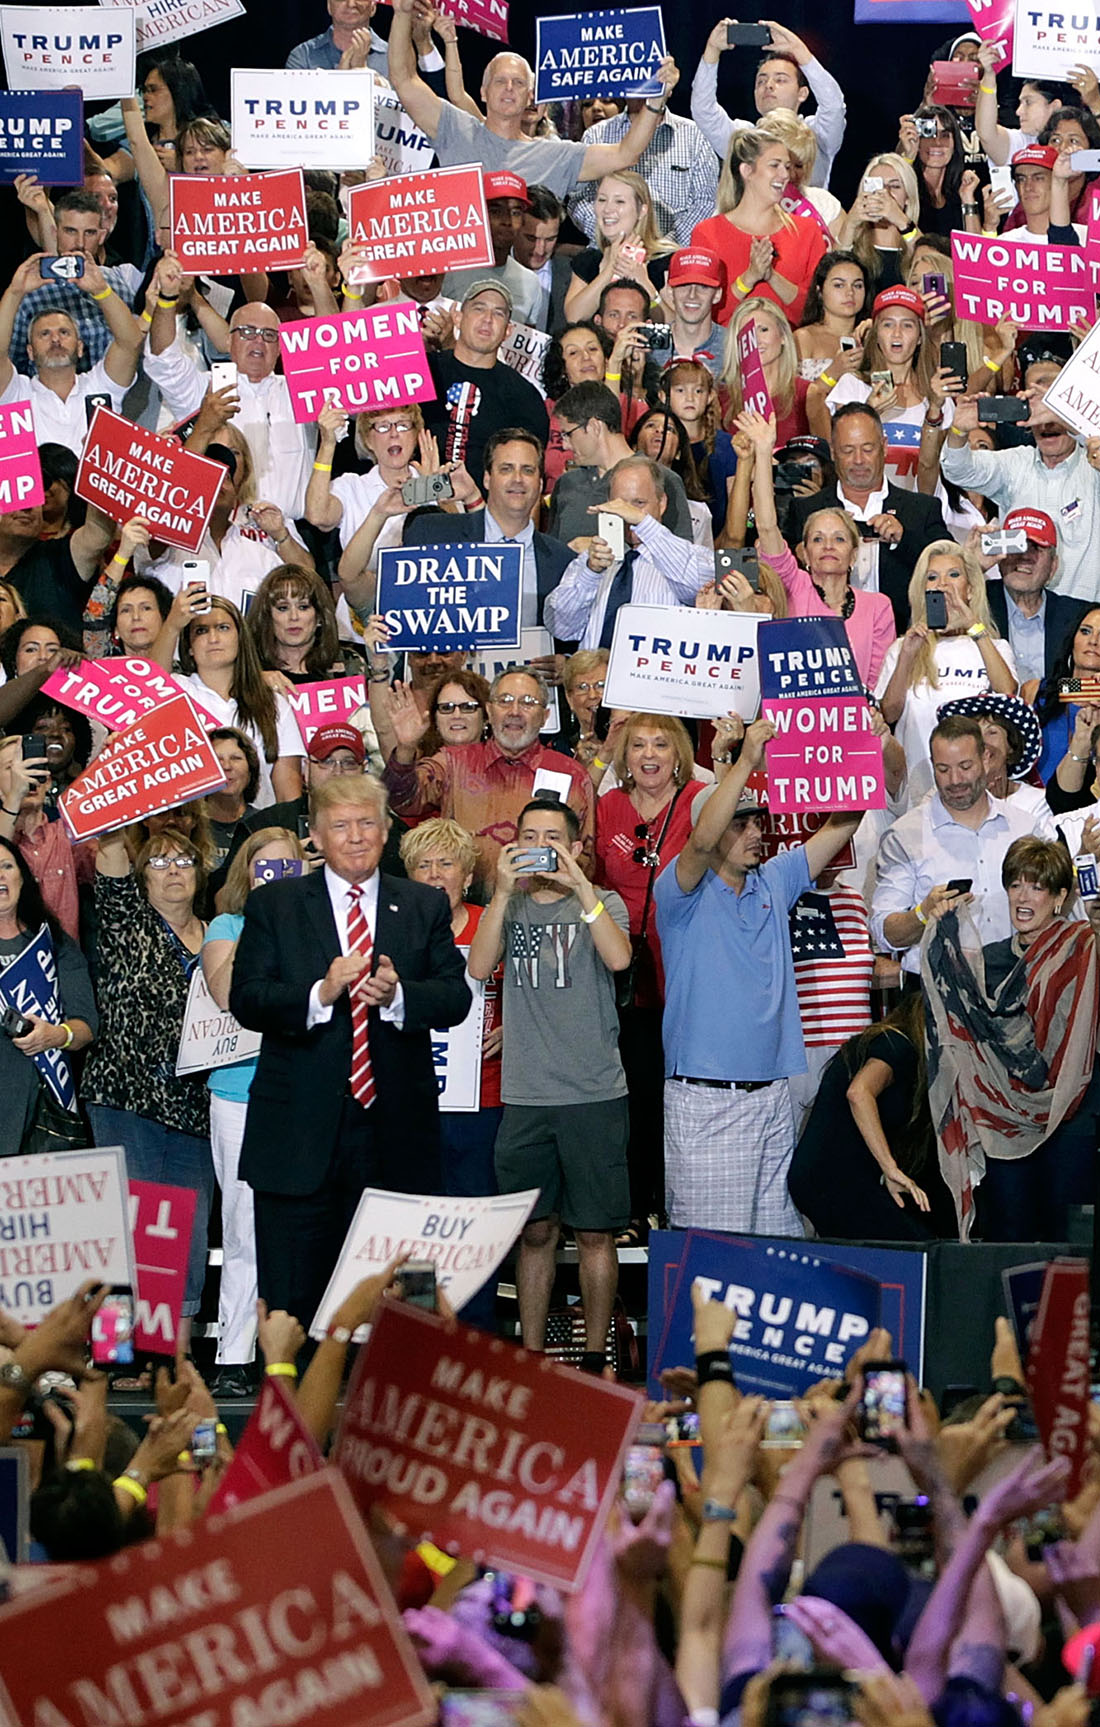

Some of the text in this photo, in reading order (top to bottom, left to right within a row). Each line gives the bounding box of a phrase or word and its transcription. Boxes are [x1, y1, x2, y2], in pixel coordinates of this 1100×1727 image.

[12, 33, 123, 51] TRUMP
[580, 25, 624, 42] MAKE
[23, 53, 113, 64] PENCE
[540, 41, 664, 71] AMERICA
[551, 67, 653, 88] SAFE AGAIN
[244, 100, 360, 115] TRUMP
[0, 118, 72, 135] UMP
[255, 119, 349, 130] PENCE
[375, 123, 431, 151] UMP
[0, 137, 63, 149] ENCE
[214, 191, 262, 207] MAKE
[389, 189, 435, 209] MAKE
[174, 205, 305, 236] AMERICA
[354, 204, 483, 242] AMERICA
[182, 234, 299, 257] GREAT AGAIN
[361, 232, 477, 261] GREAT AGAIN
[954, 238, 1086, 273] WOMEN
[997, 277, 1047, 295] FOR
[962, 294, 1088, 325] TRUMP
[280, 309, 419, 353] WOMEN
[513, 334, 547, 358] BUY
[330, 353, 379, 375] FOR
[298, 372, 424, 414] TRUMP
[129, 441, 174, 475] MAKE
[84, 444, 206, 519] AMERICA
[88, 472, 193, 534] GREAT AGAIN
[395, 556, 504, 586] DRAIN
[426, 586, 467, 605] THE
[385, 606, 510, 636] SWAMP
[628, 635, 754, 664] TRUMP
[769, 648, 851, 673] TRUMP
[630, 673, 652, 682] MAKE
[653, 676, 690, 687] AMERICA
[691, 680, 717, 689] GREAT
[637, 657, 741, 680] PENCE
[781, 669, 854, 688] PENCE
[59, 672, 140, 727] TRUM
[109, 674, 156, 710] FOR
[287, 682, 366, 714] MEN
[779, 691, 795, 699] MAKE
[797, 689, 821, 697] AMERICA
[766, 706, 874, 734] WOMEN
[98, 728, 147, 762] MAKE
[804, 745, 843, 764] FOR
[64, 726, 205, 806] AMERICA
[79, 755, 204, 816] GREAT AGAIN
[774, 774, 877, 803] TRUMP
[511, 922, 580, 989] NY
[212, 1035, 239, 1057] BUY
[421, 1214, 474, 1240] BUY
[695, 1276, 869, 1341] TRUMP
[736, 1319, 847, 1363] ENCE
[726, 1342, 845, 1379] MERICA GREAT AGAIN
[431, 1357, 533, 1420] MAKE
[346, 1378, 599, 1510] AMERICA
[341, 1436, 585, 1550] PROUD AGAIN
[106, 1557, 241, 1642] MAKE
